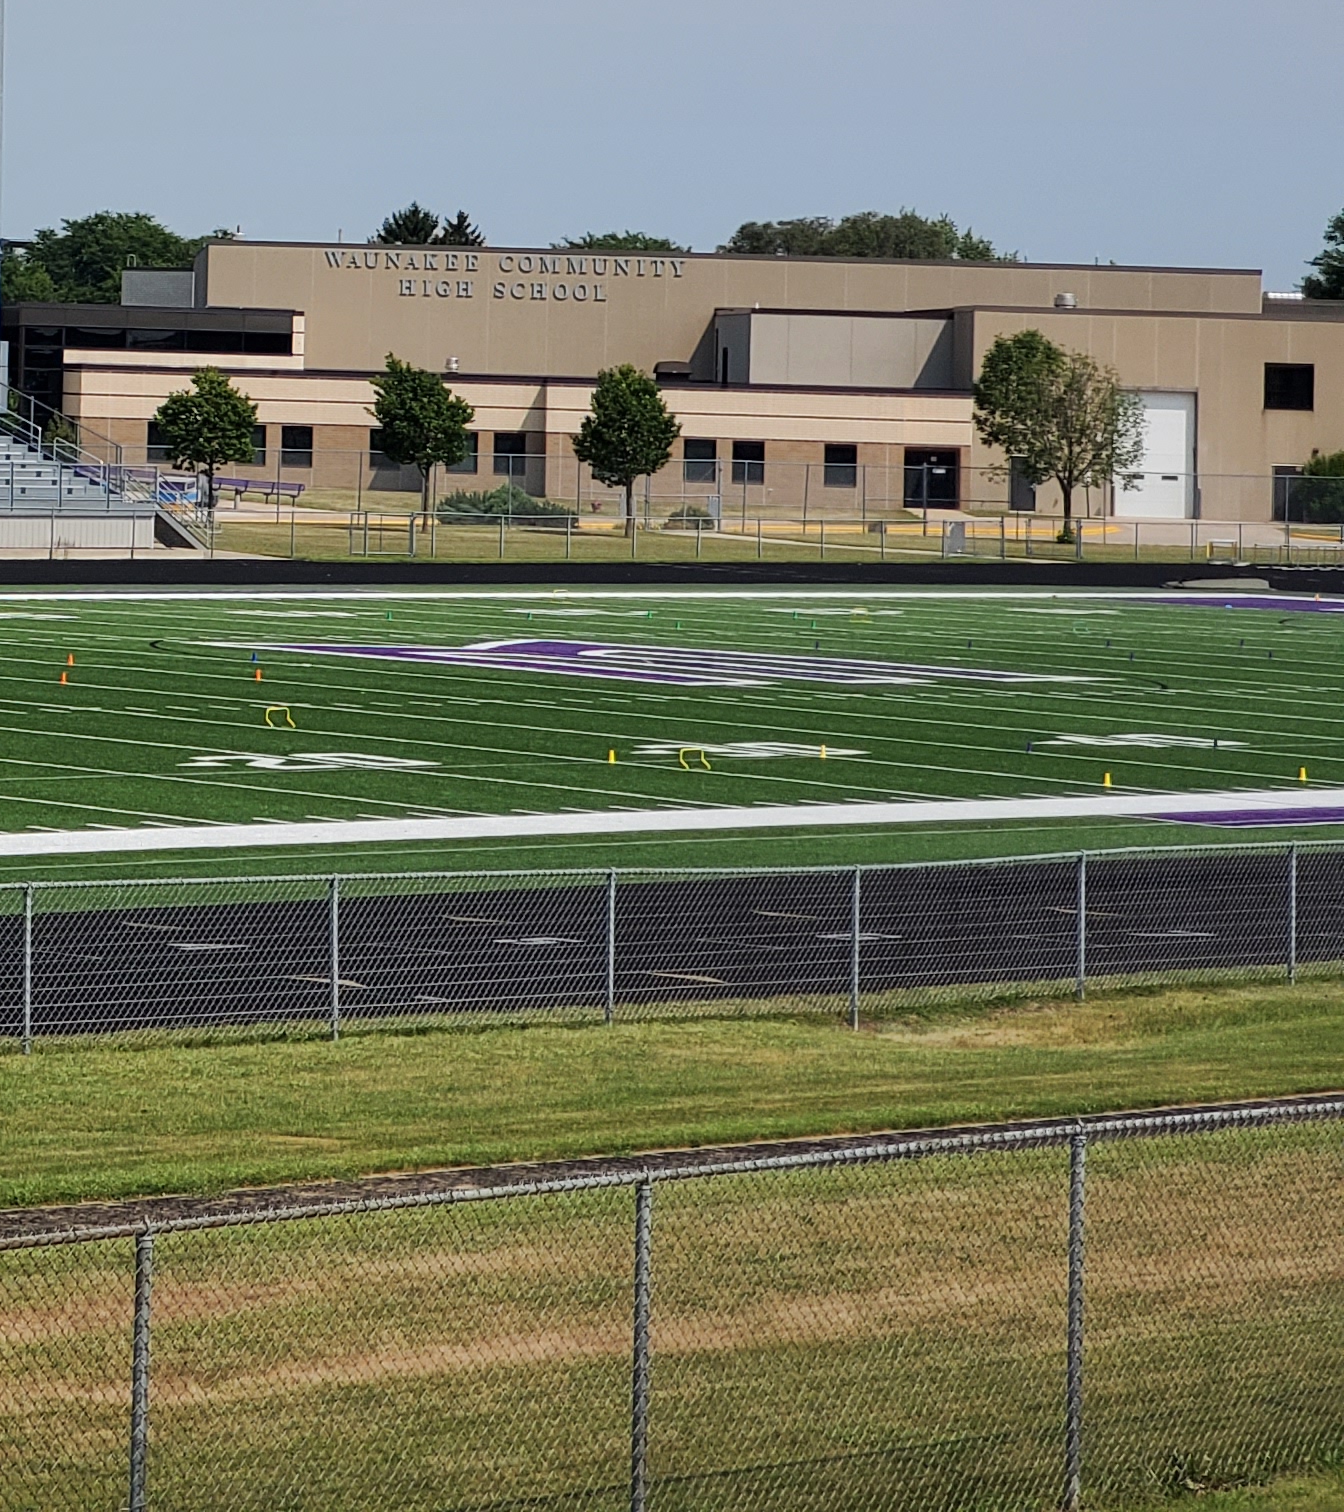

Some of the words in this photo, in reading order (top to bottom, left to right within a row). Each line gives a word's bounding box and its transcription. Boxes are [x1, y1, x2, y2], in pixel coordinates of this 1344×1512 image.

[323, 249, 480, 272] WAUNAKEE
[498, 255, 686, 278] COMMUNITY
[398, 278, 474, 299] HIGH
[492, 280, 609, 302] SCHOOL
